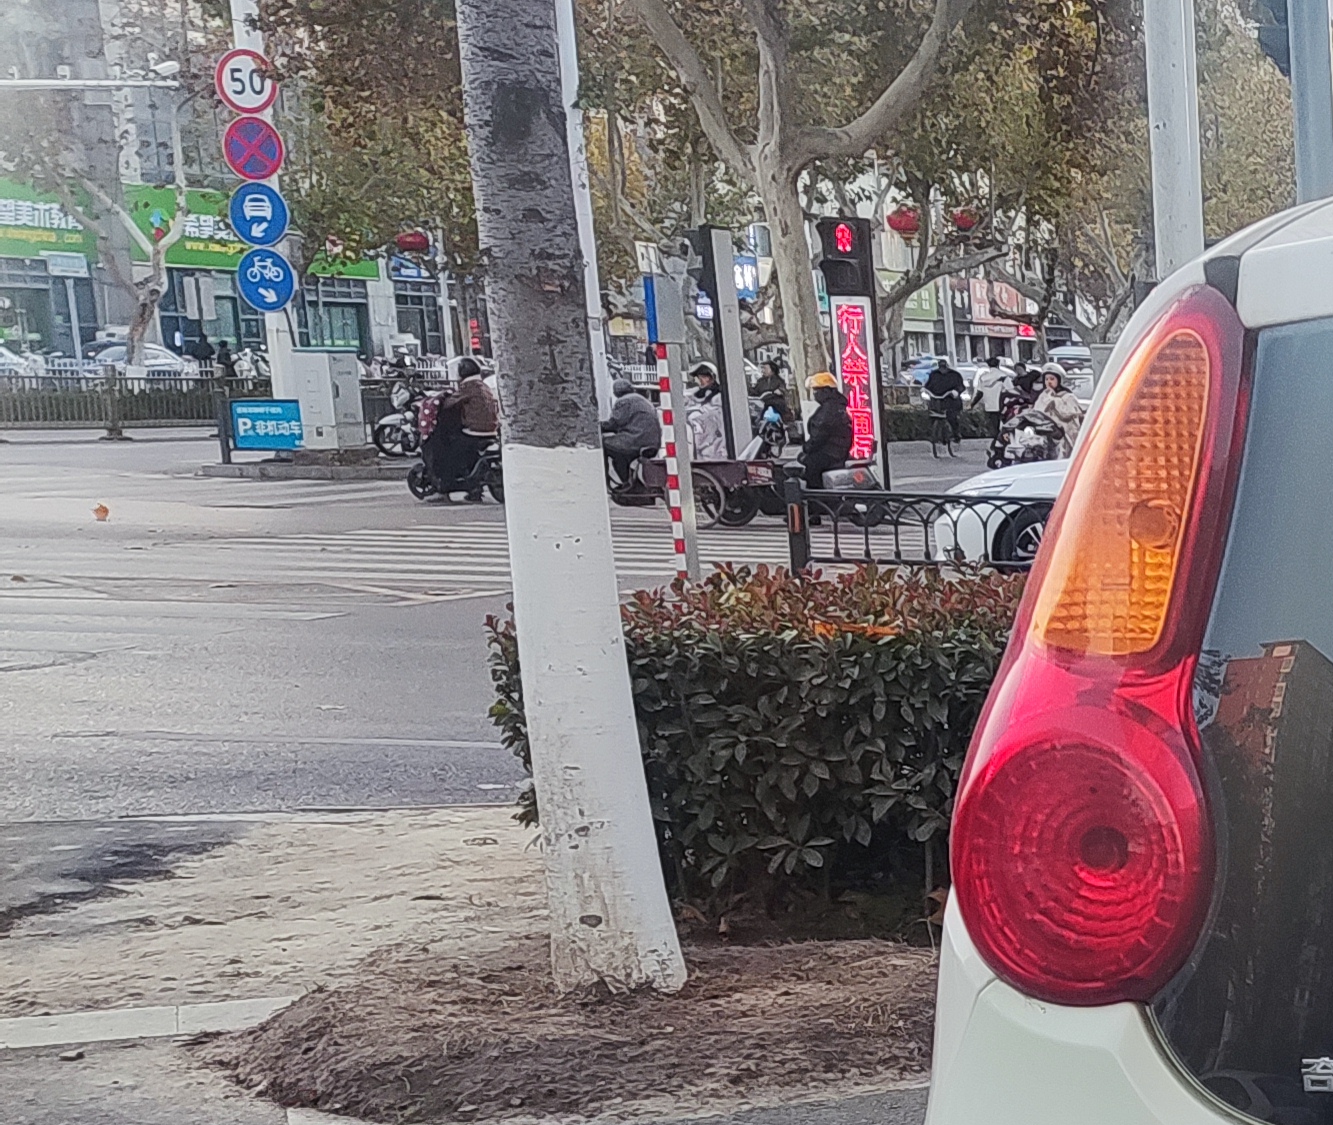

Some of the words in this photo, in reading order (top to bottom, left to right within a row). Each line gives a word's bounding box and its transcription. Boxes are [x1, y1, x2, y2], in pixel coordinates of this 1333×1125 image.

[229, 67, 266, 96] 50
[237, 417, 251, 436] P
[253, 420, 302, 436] 非机动车
